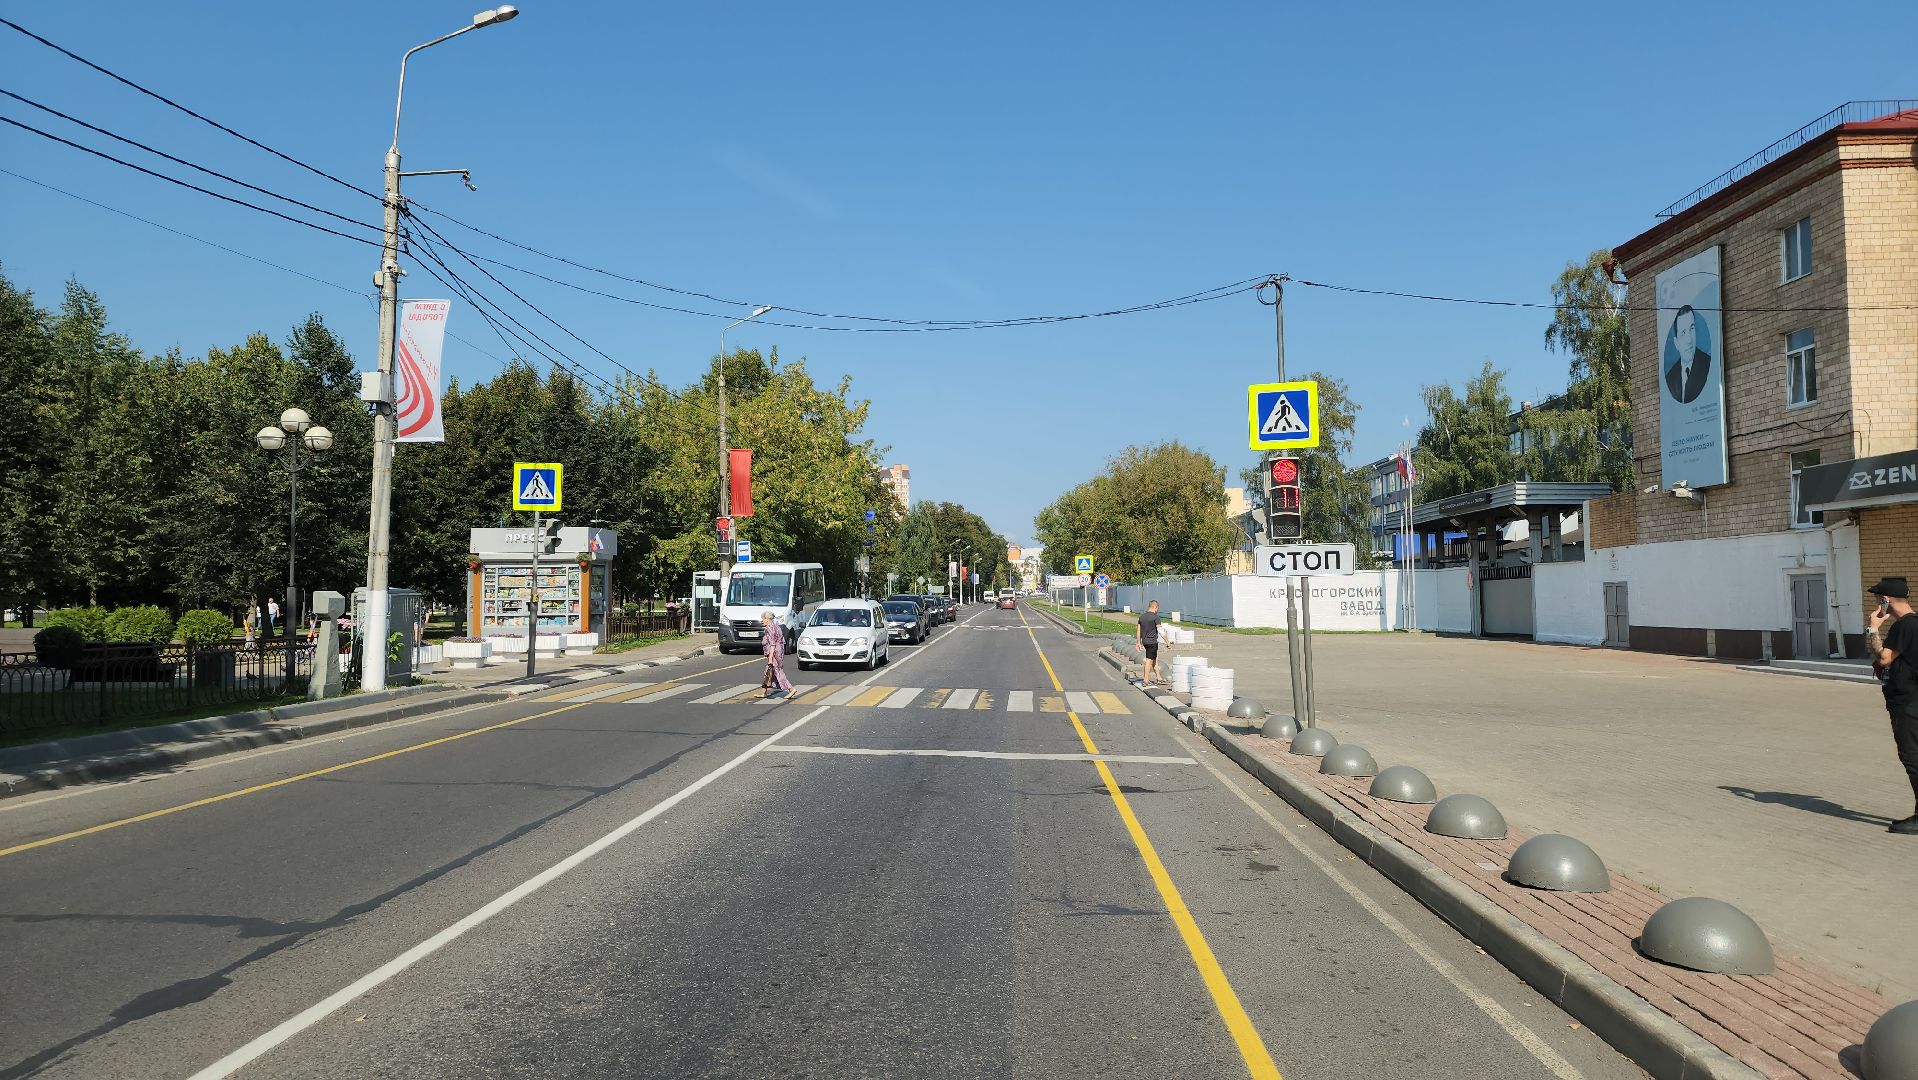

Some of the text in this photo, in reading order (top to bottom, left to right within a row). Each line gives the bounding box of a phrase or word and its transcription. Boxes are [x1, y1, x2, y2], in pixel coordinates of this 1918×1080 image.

[1874, 464, 1917, 486] ZEN
[1269, 551, 1341, 571] СТОП
[1269, 586, 1383, 598] КРСОГОРСКИЙ
[1340, 600, 1384, 610] ЗАВОД
